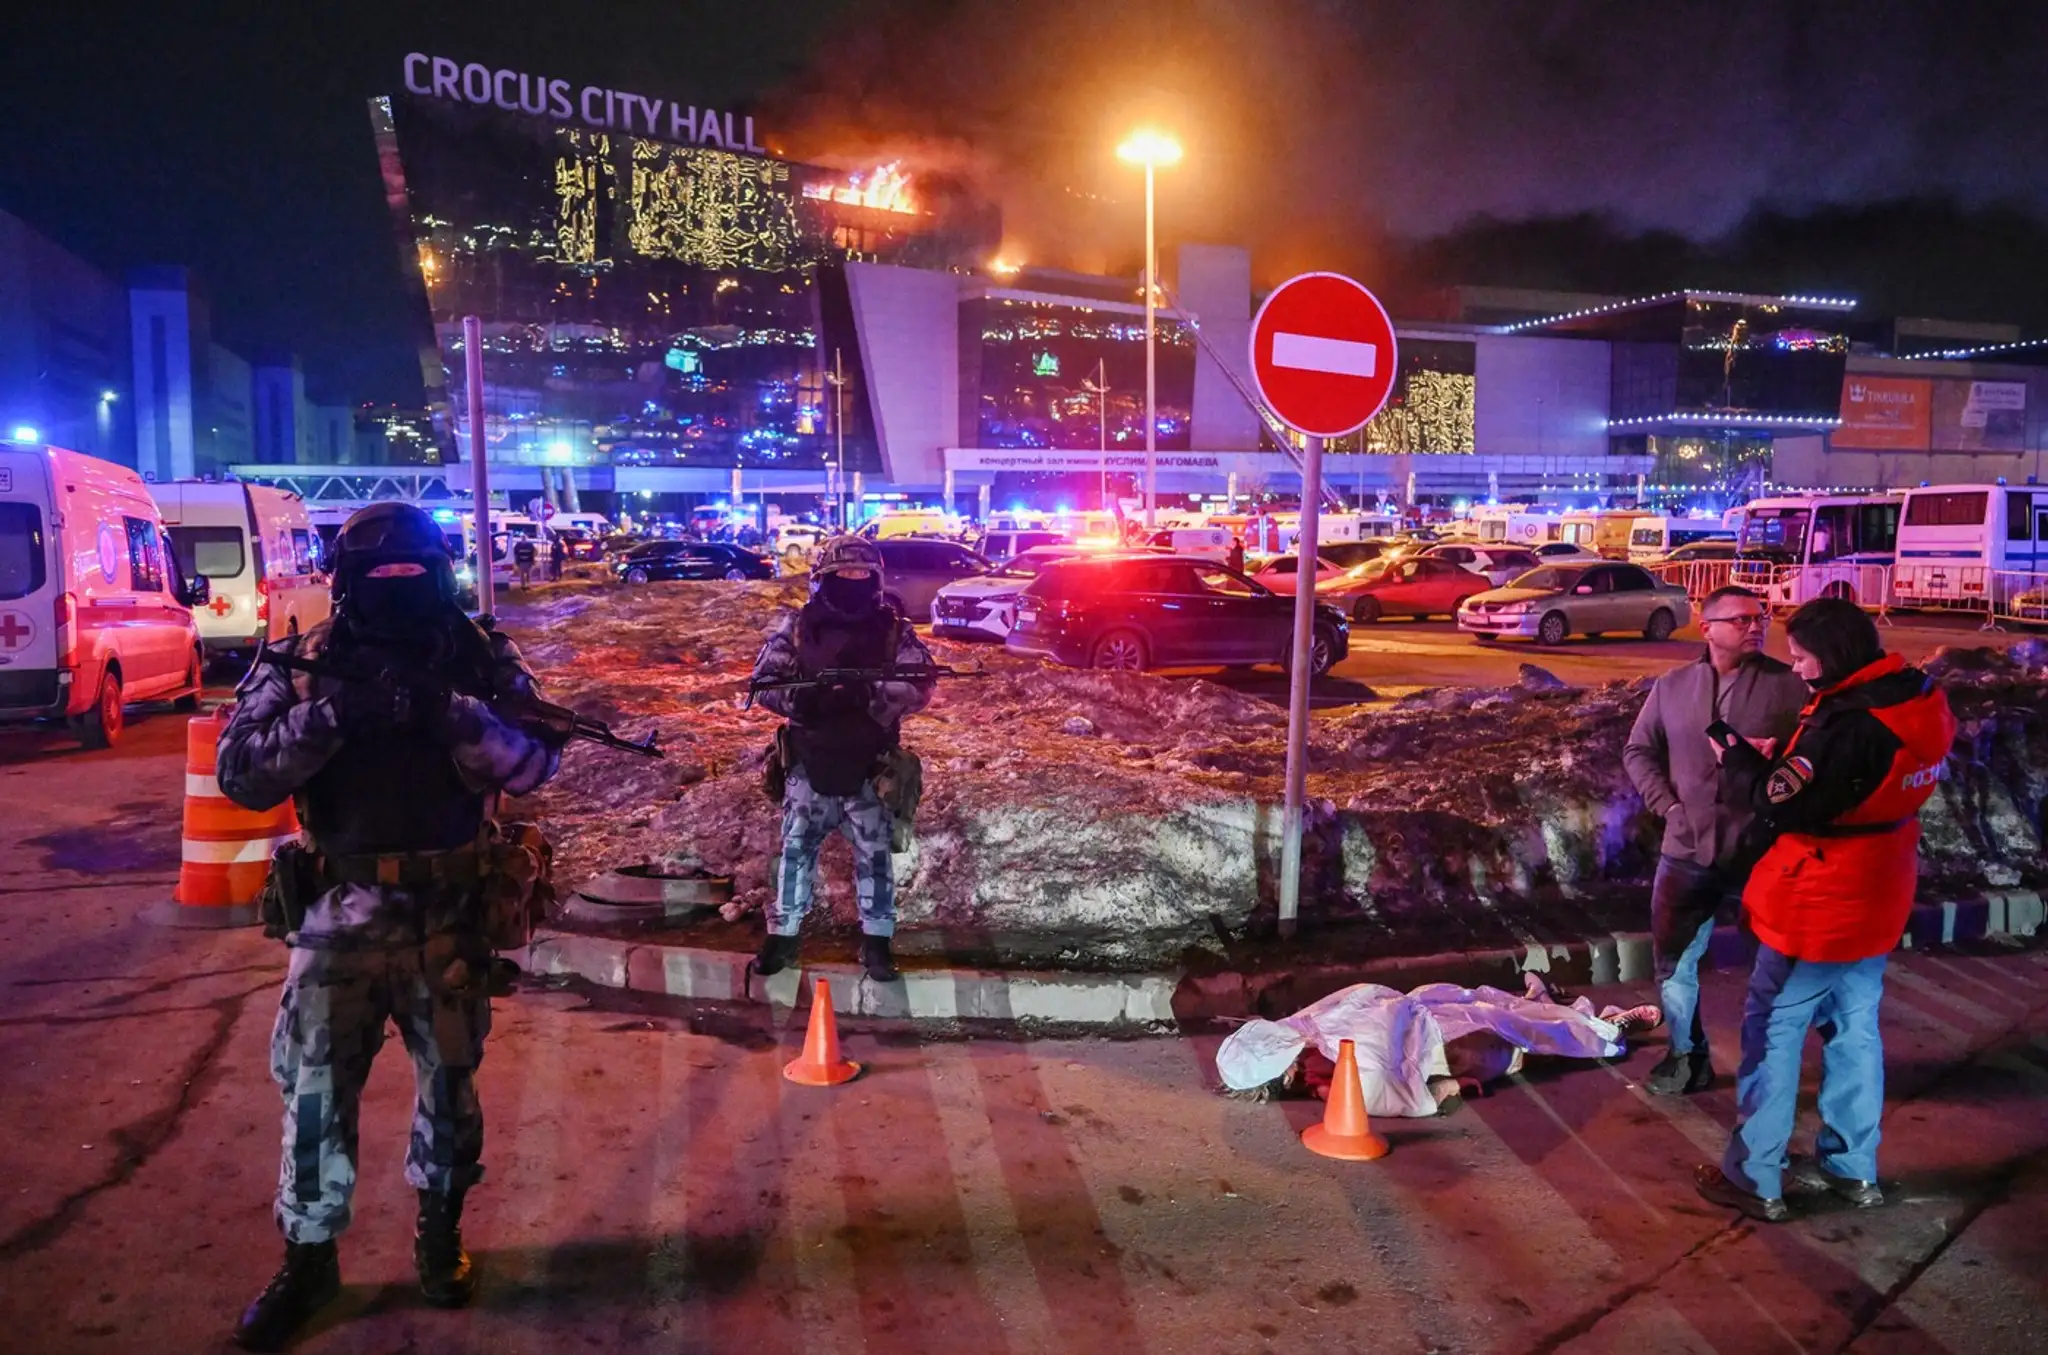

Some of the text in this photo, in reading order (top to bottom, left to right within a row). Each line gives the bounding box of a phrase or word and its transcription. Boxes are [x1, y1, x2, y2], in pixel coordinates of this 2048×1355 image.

[403, 52, 766, 154] CROCUS CITY HALL
[1155, 456, 1219, 467] МАГОМАЕВА
